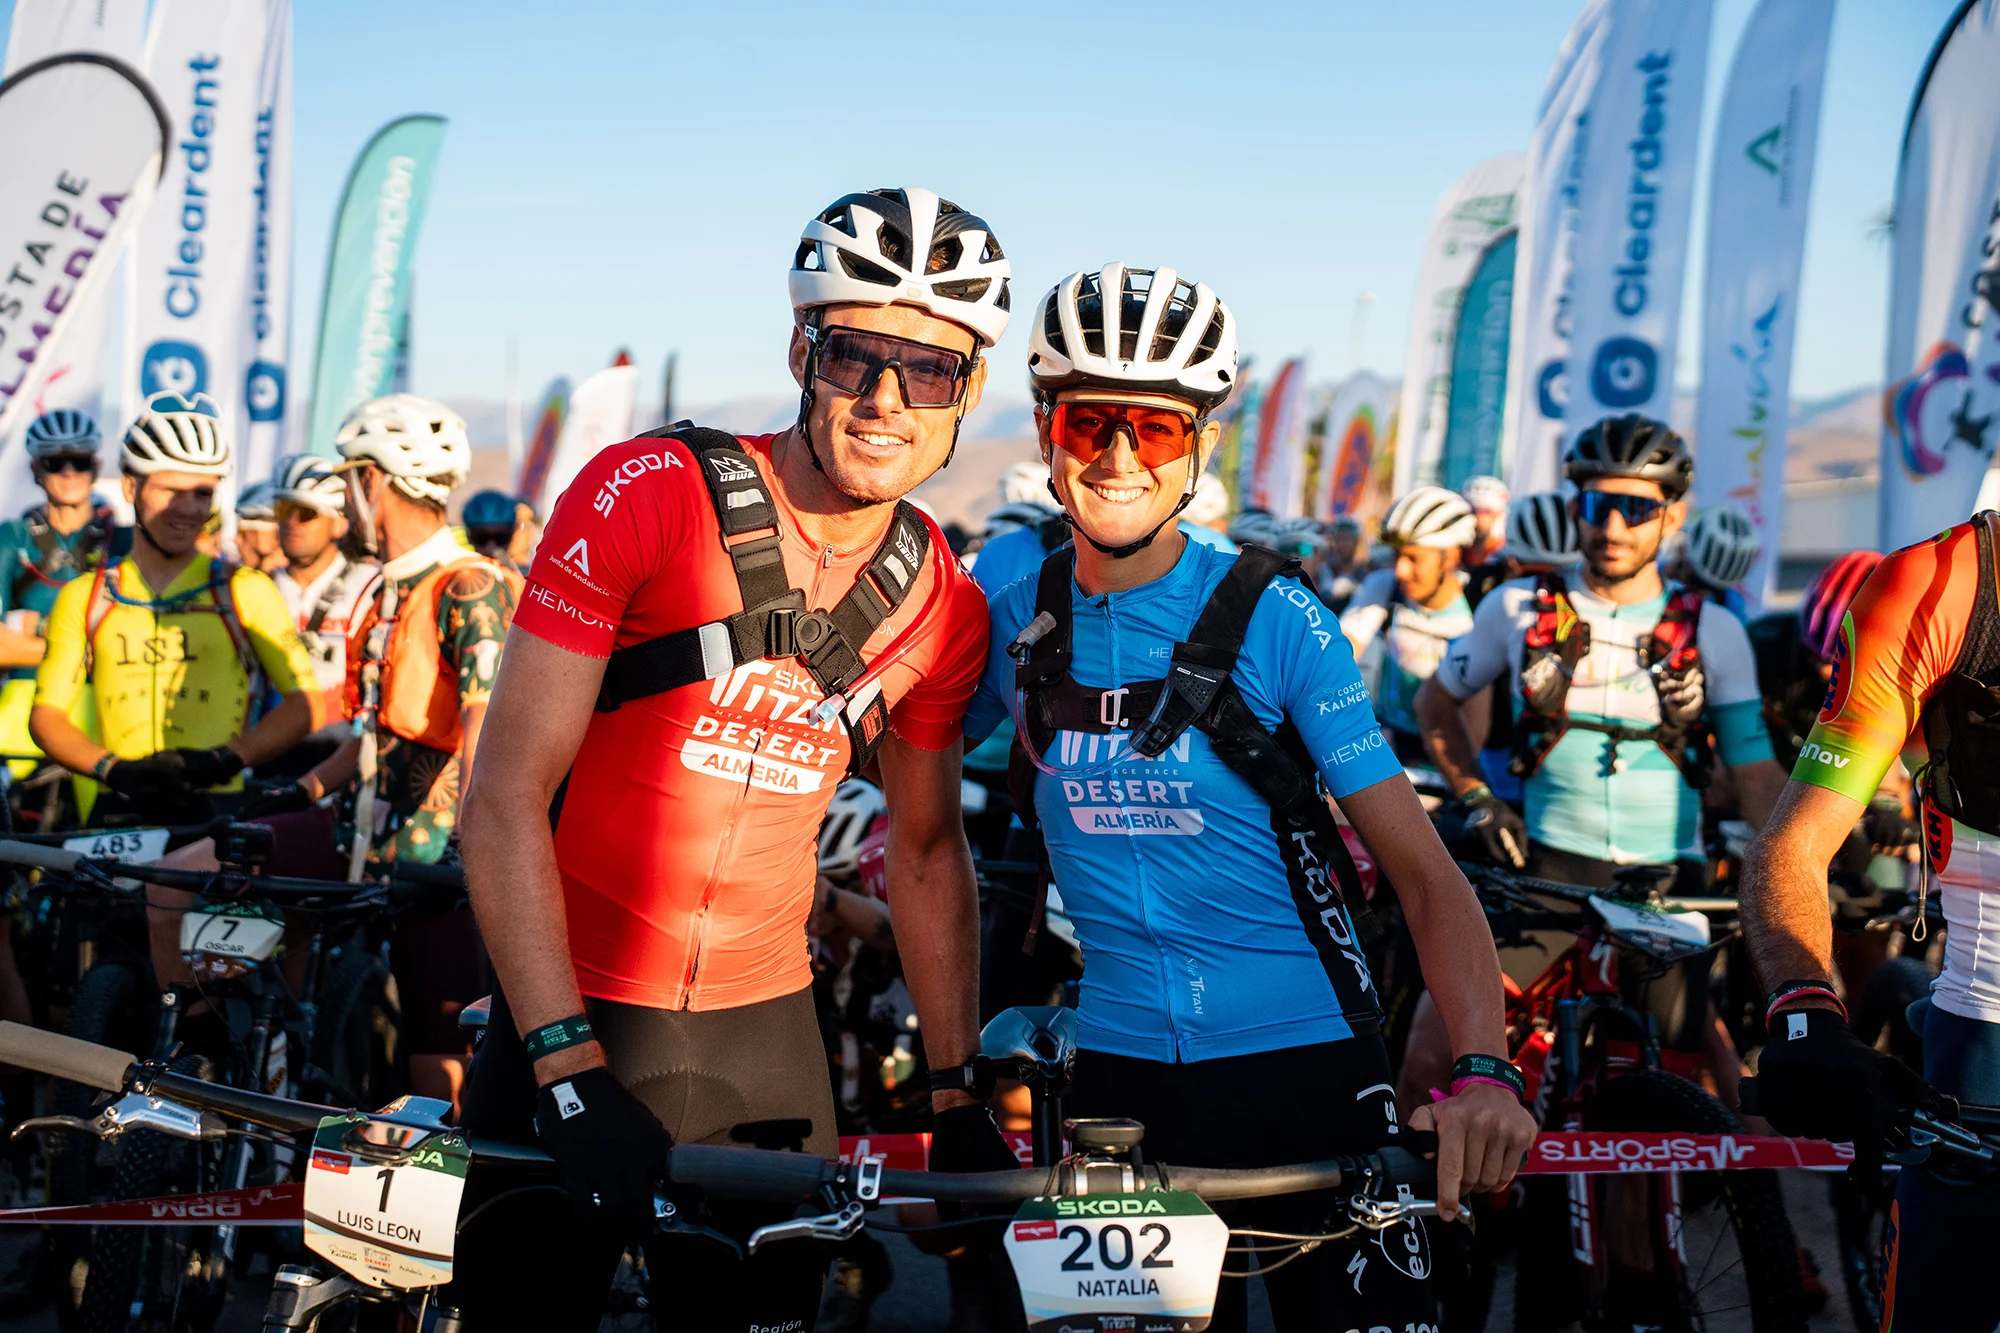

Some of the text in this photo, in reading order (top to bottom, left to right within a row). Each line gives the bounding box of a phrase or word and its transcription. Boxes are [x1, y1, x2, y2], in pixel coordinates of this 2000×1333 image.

[40, 168, 89, 229] DE
[164, 52, 221, 319] Cleardent
[1613, 47, 1673, 318] Cleardent
[549, 555, 564, 569] Junta
[564, 565, 573, 575] de
[1267, 579, 1332, 652] KODA
[692, 714, 839, 768] DESERT
[715, 710, 837, 746] MTB STAGE RACE
[703, 753, 799, 791] ALMERÍA
[1145, 768, 1179, 776] RACE
[1062, 779, 1194, 804] DESERT
[1094, 811, 1180, 830] ALMERÍA
[91, 833, 143, 855] 483
[222, 919, 240, 941] 7
[1539, 1138, 1698, 1161] SPORTS
[376, 1167, 396, 1213] 1
[337, 1210, 422, 1244] LUIS LEON
[1058, 1222, 1174, 1272] 202
[1077, 1279, 1160, 1297] NATALIA
